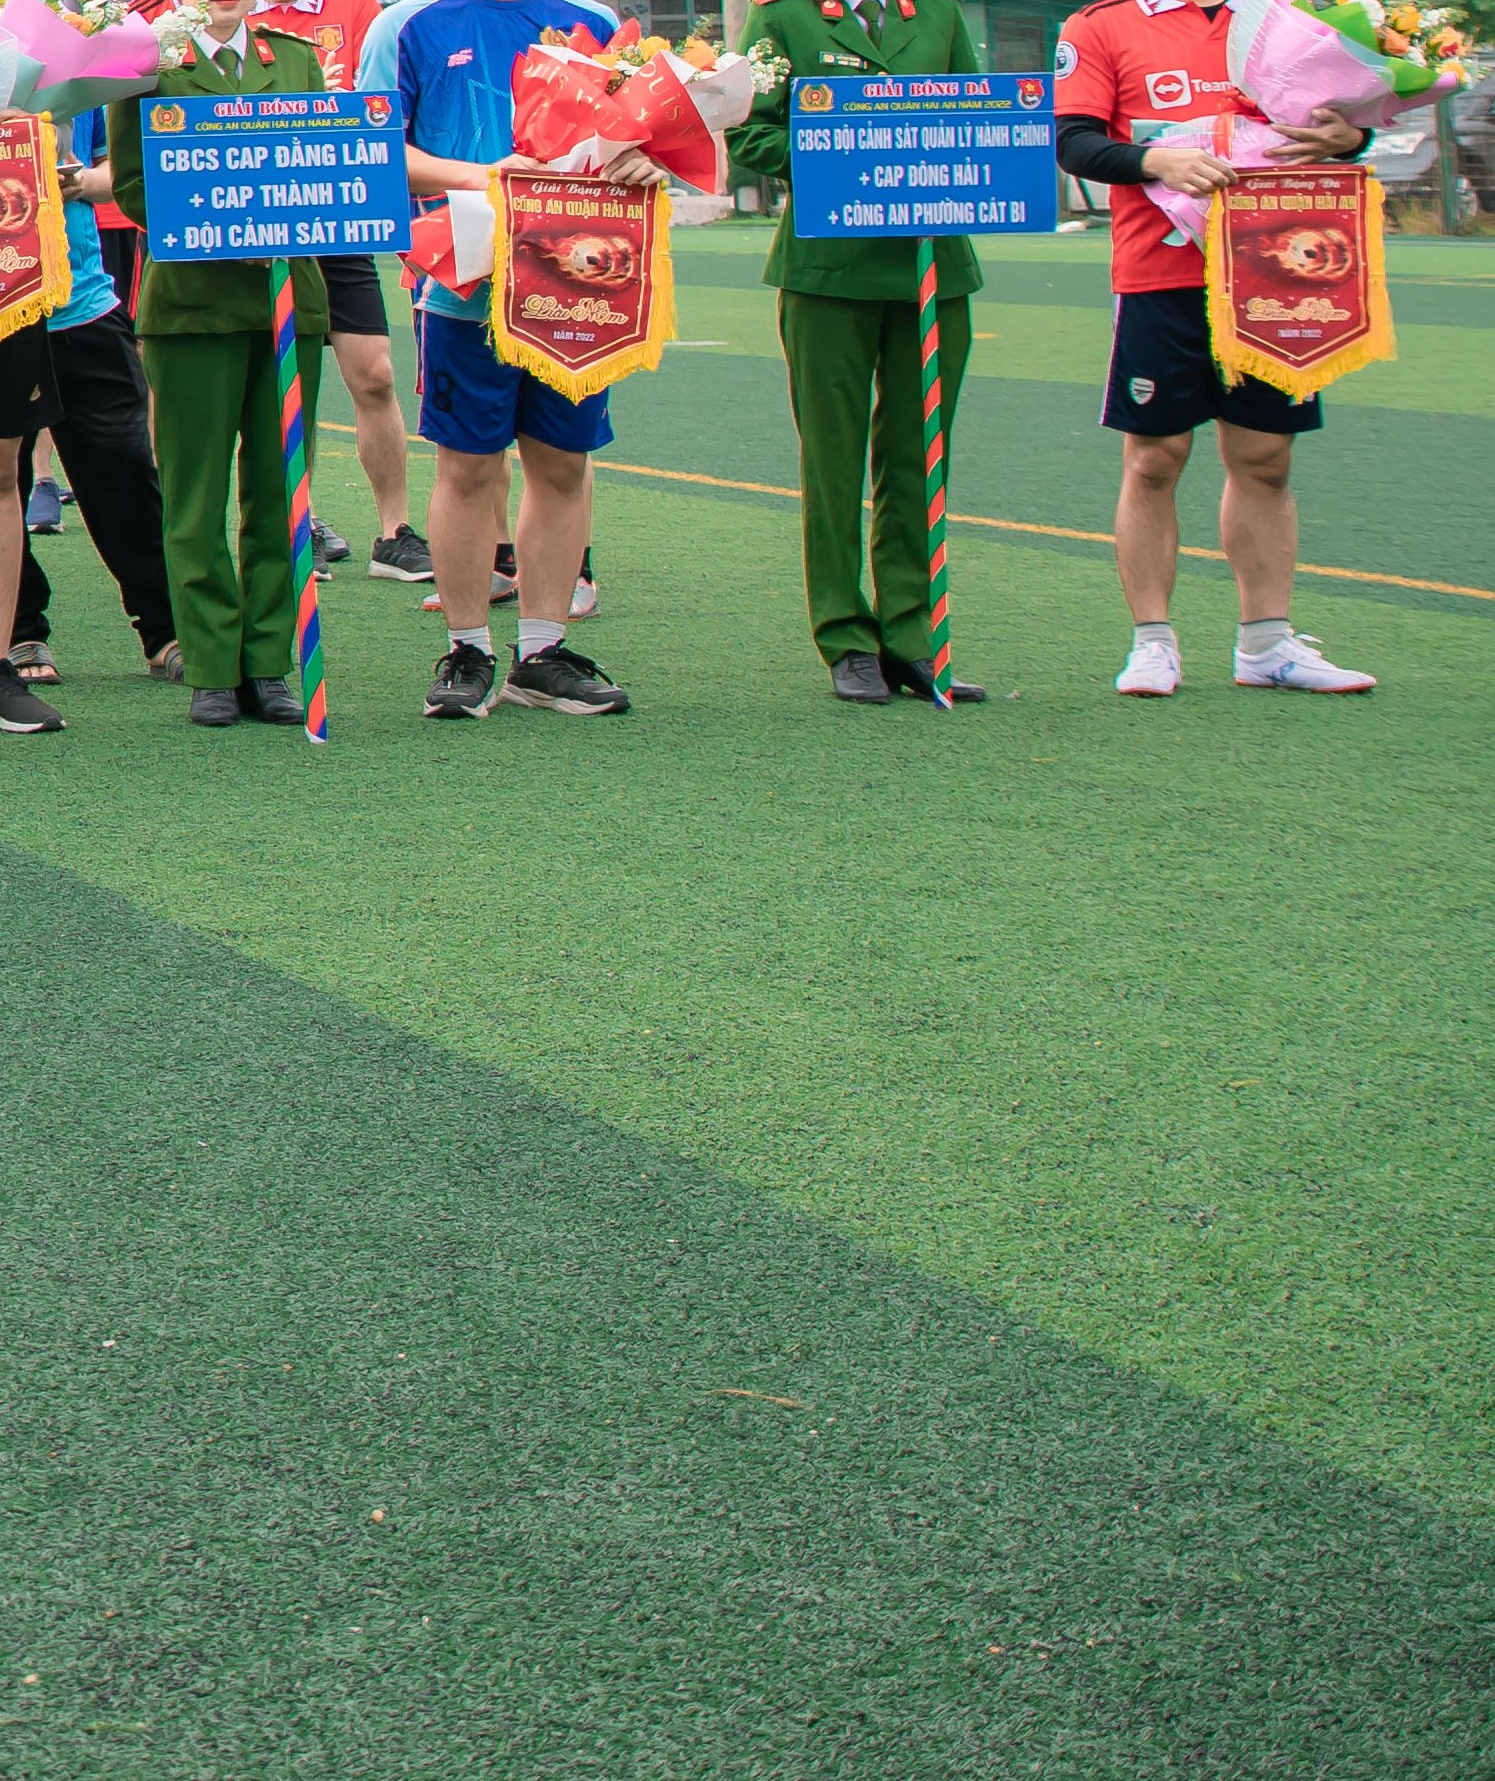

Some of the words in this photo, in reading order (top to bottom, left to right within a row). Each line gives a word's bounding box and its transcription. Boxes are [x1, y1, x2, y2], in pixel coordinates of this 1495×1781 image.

[214, 97, 253, 117] GIẢI
[258, 98, 308, 115] BÓNG
[313, 96, 339, 113] ĐÁ
[799, 129, 831, 150] CBCS
[835, 125, 855, 154] ĐỘI
[859, 121, 892, 149] CẢNH
[896, 123, 918, 149] SÁT
[923, 120, 955, 150] QUẢN
[958, 120, 974, 148] LÝ
[976, 121, 1010, 147] HÀNH
[1013, 120, 1050, 146] CHÍNH
[161, 148, 219, 172] CBCS
[227, 147, 268, 169] CAP
[275, 137, 336, 167] ĐẰNG
[343, 138, 388, 165] LÂM
[875, 166, 904, 187] CAP
[909, 161, 949, 186] ĐÔNG
[955, 157, 978, 185] HẢI
[985, 165, 990, 184] 1
[212, 186, 253, 209] CAP
[261, 180, 333, 207] THÀNH
[339, 177, 366, 204] TÔ
[844, 200, 884, 226] CÔNG
[889, 204, 909, 224] AN
[913, 197, 975, 225] PHƯỜNG
[980, 197, 1006, 223] CÁT
[1012, 202, 1025, 222] BI
[185, 222, 221, 252] ĐỘI
[229, 217, 289, 247] CẢNH
[297, 217, 336, 244] SÁT
[345, 220, 395, 242] HTTP
